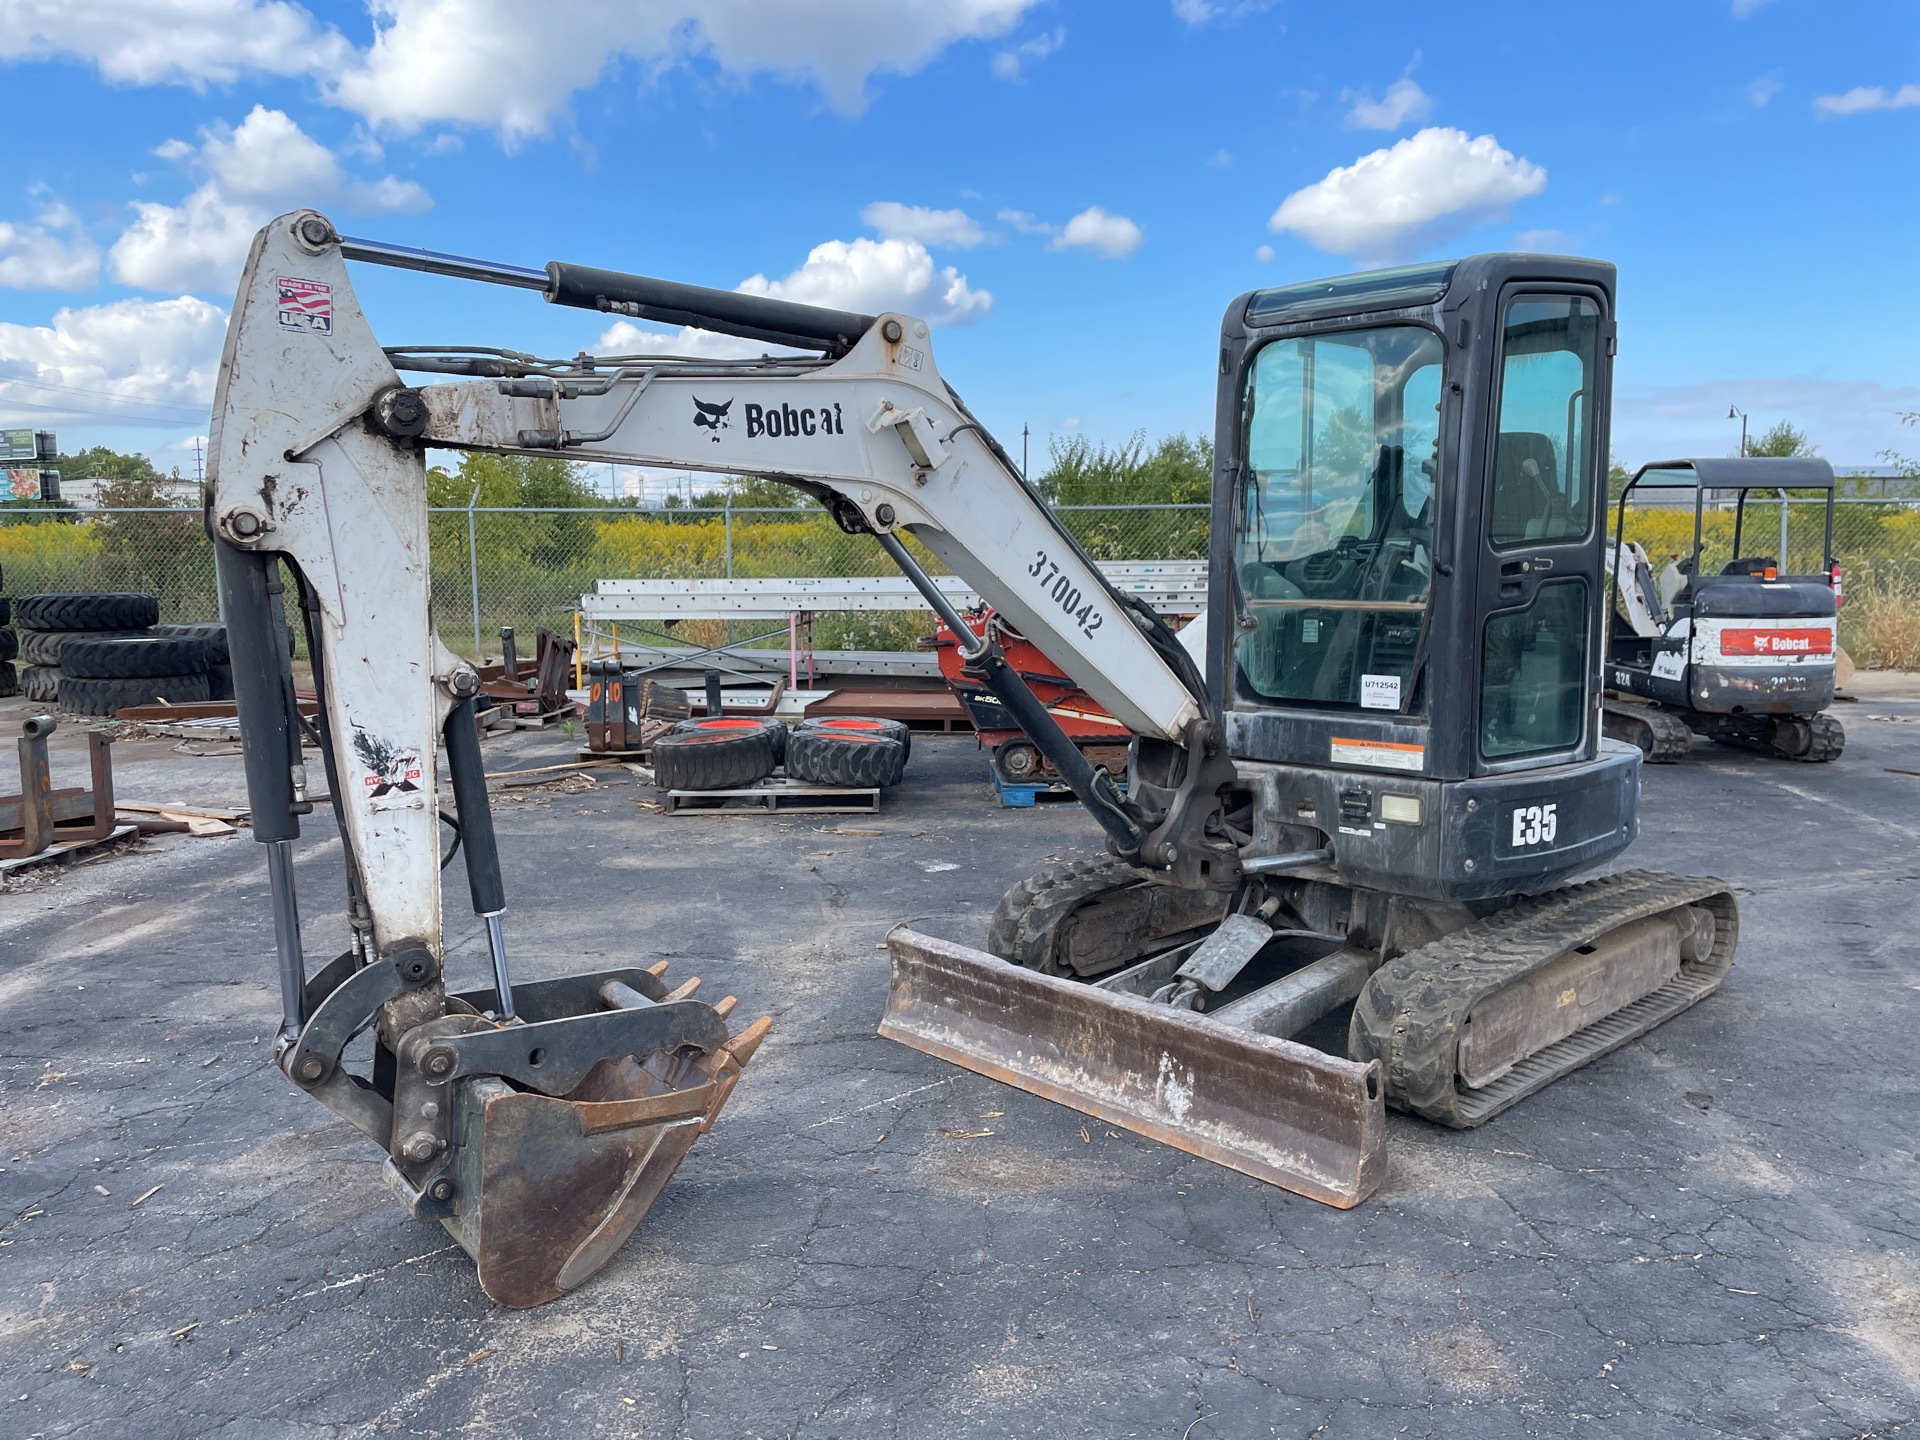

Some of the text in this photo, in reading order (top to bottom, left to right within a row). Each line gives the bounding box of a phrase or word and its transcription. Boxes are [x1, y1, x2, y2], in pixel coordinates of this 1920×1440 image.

[281, 281, 303, 289] MADE
[744, 402, 844, 438] Bobcat
[1027, 550, 1103, 640] 370042
[1771, 637, 1810, 651] Bobcat
[1365, 681, 1399, 690] U712542
[1615, 671, 1631, 687] 324
[609, 681, 621, 703] 10
[1512, 803, 1557, 847] E35
